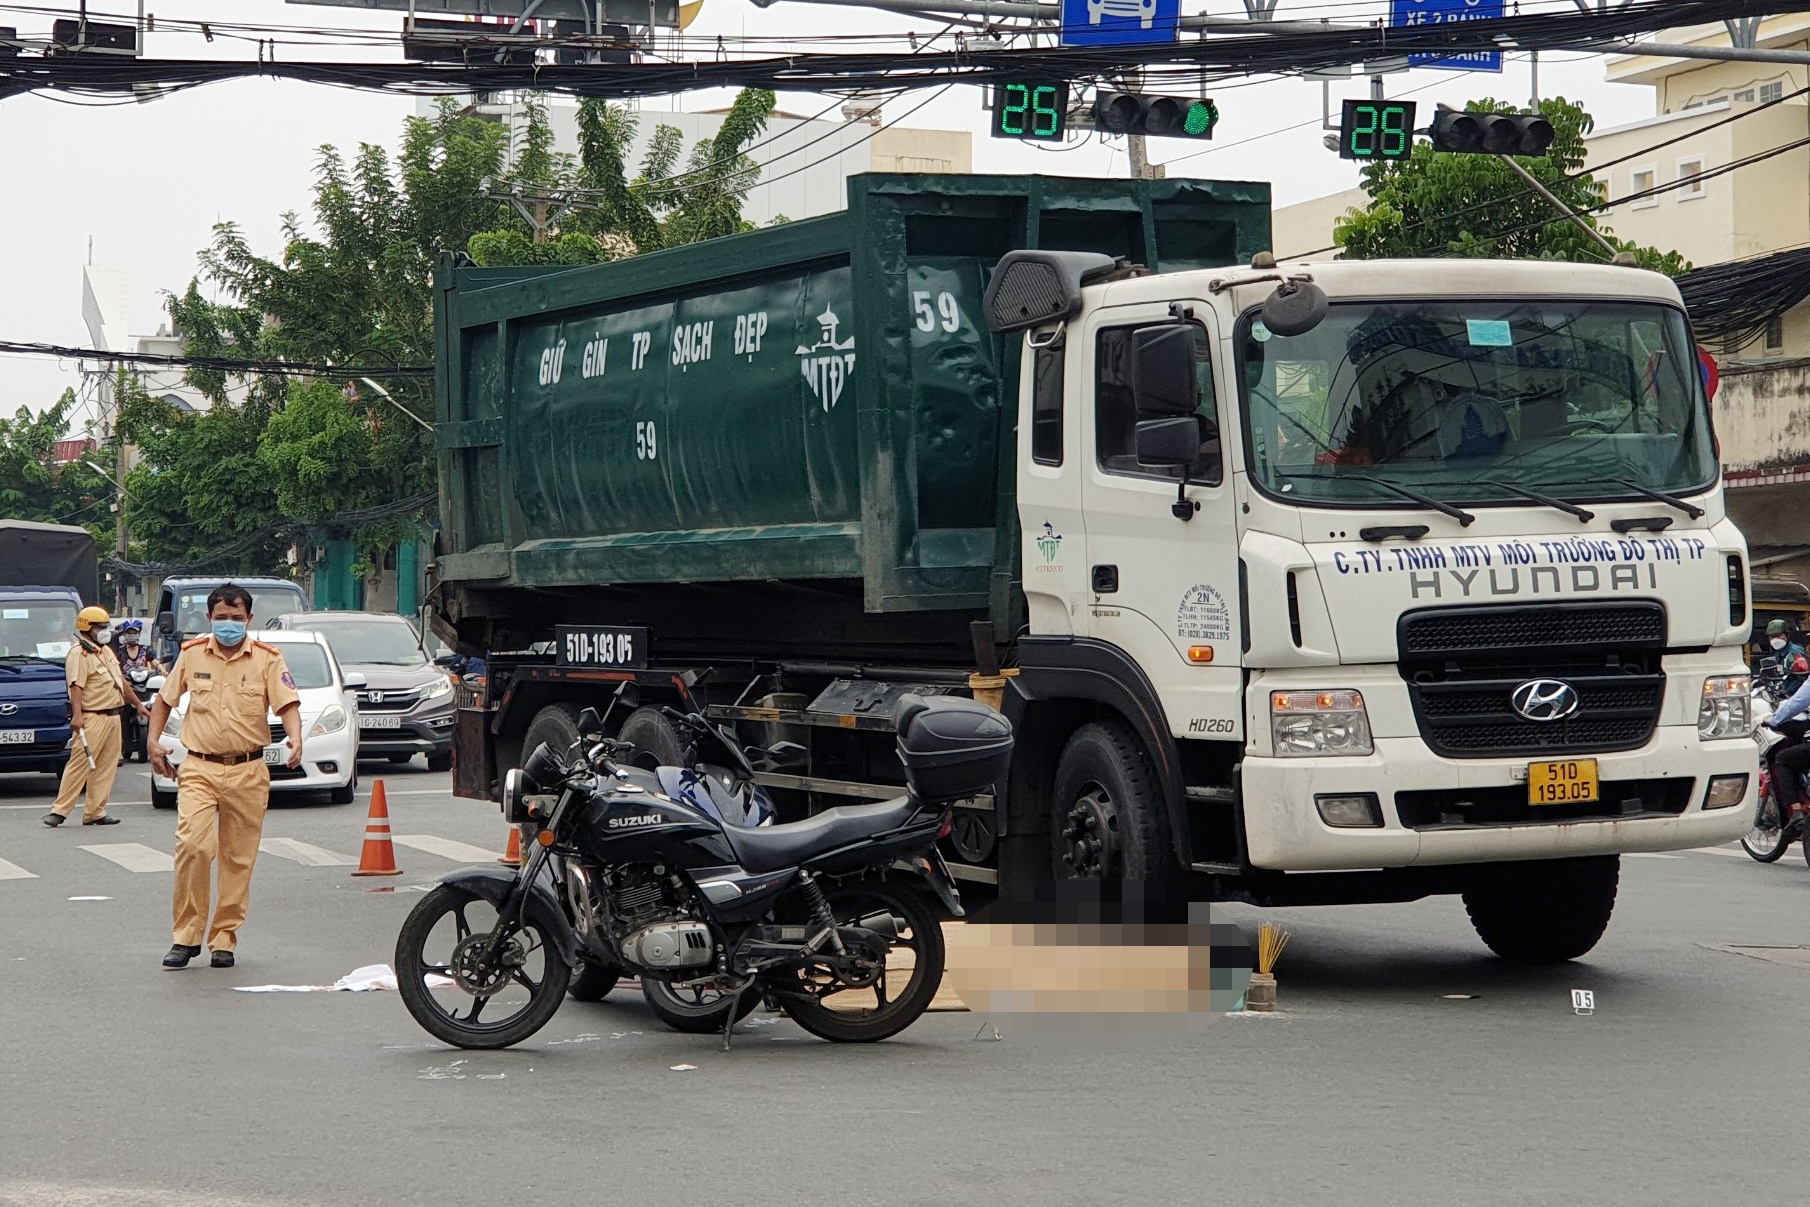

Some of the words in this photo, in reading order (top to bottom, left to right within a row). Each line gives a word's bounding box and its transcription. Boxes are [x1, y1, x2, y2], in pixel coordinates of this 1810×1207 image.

[1002, 84, 1057, 136] 25
[1351, 106, 1405, 155] 25
[913, 290, 960, 333] 59
[539, 338, 567, 386] GIỮ
[582, 331, 608, 379] GÌN
[631, 331, 651, 370] TP
[672, 320, 714, 373] SẠCH
[734, 311, 768, 363] ĐẸP
[636, 420, 657, 461] 59
[1450, 545, 1492, 567] MTV
[1497, 539, 1538, 565] MÔI
[1539, 535, 1617, 564] TRƯỜNG
[1617, 535, 1645, 561] ĐÔ
[1647, 538, 1681, 565] THỊ
[1682, 538, 1705, 560] TP
[1036, 565, 1064, 573] CITENCO
[1409, 562, 1657, 599] HYUNDAI
[1197, 592, 1210, 603] 2N
[1188, 718, 1235, 733] HD260
[1548, 762, 1578, 781] 51D
[1538, 781, 1591, 802] 193.05
[608, 814, 662, 828] SUZUKI
[1574, 991, 1592, 1008] 05
